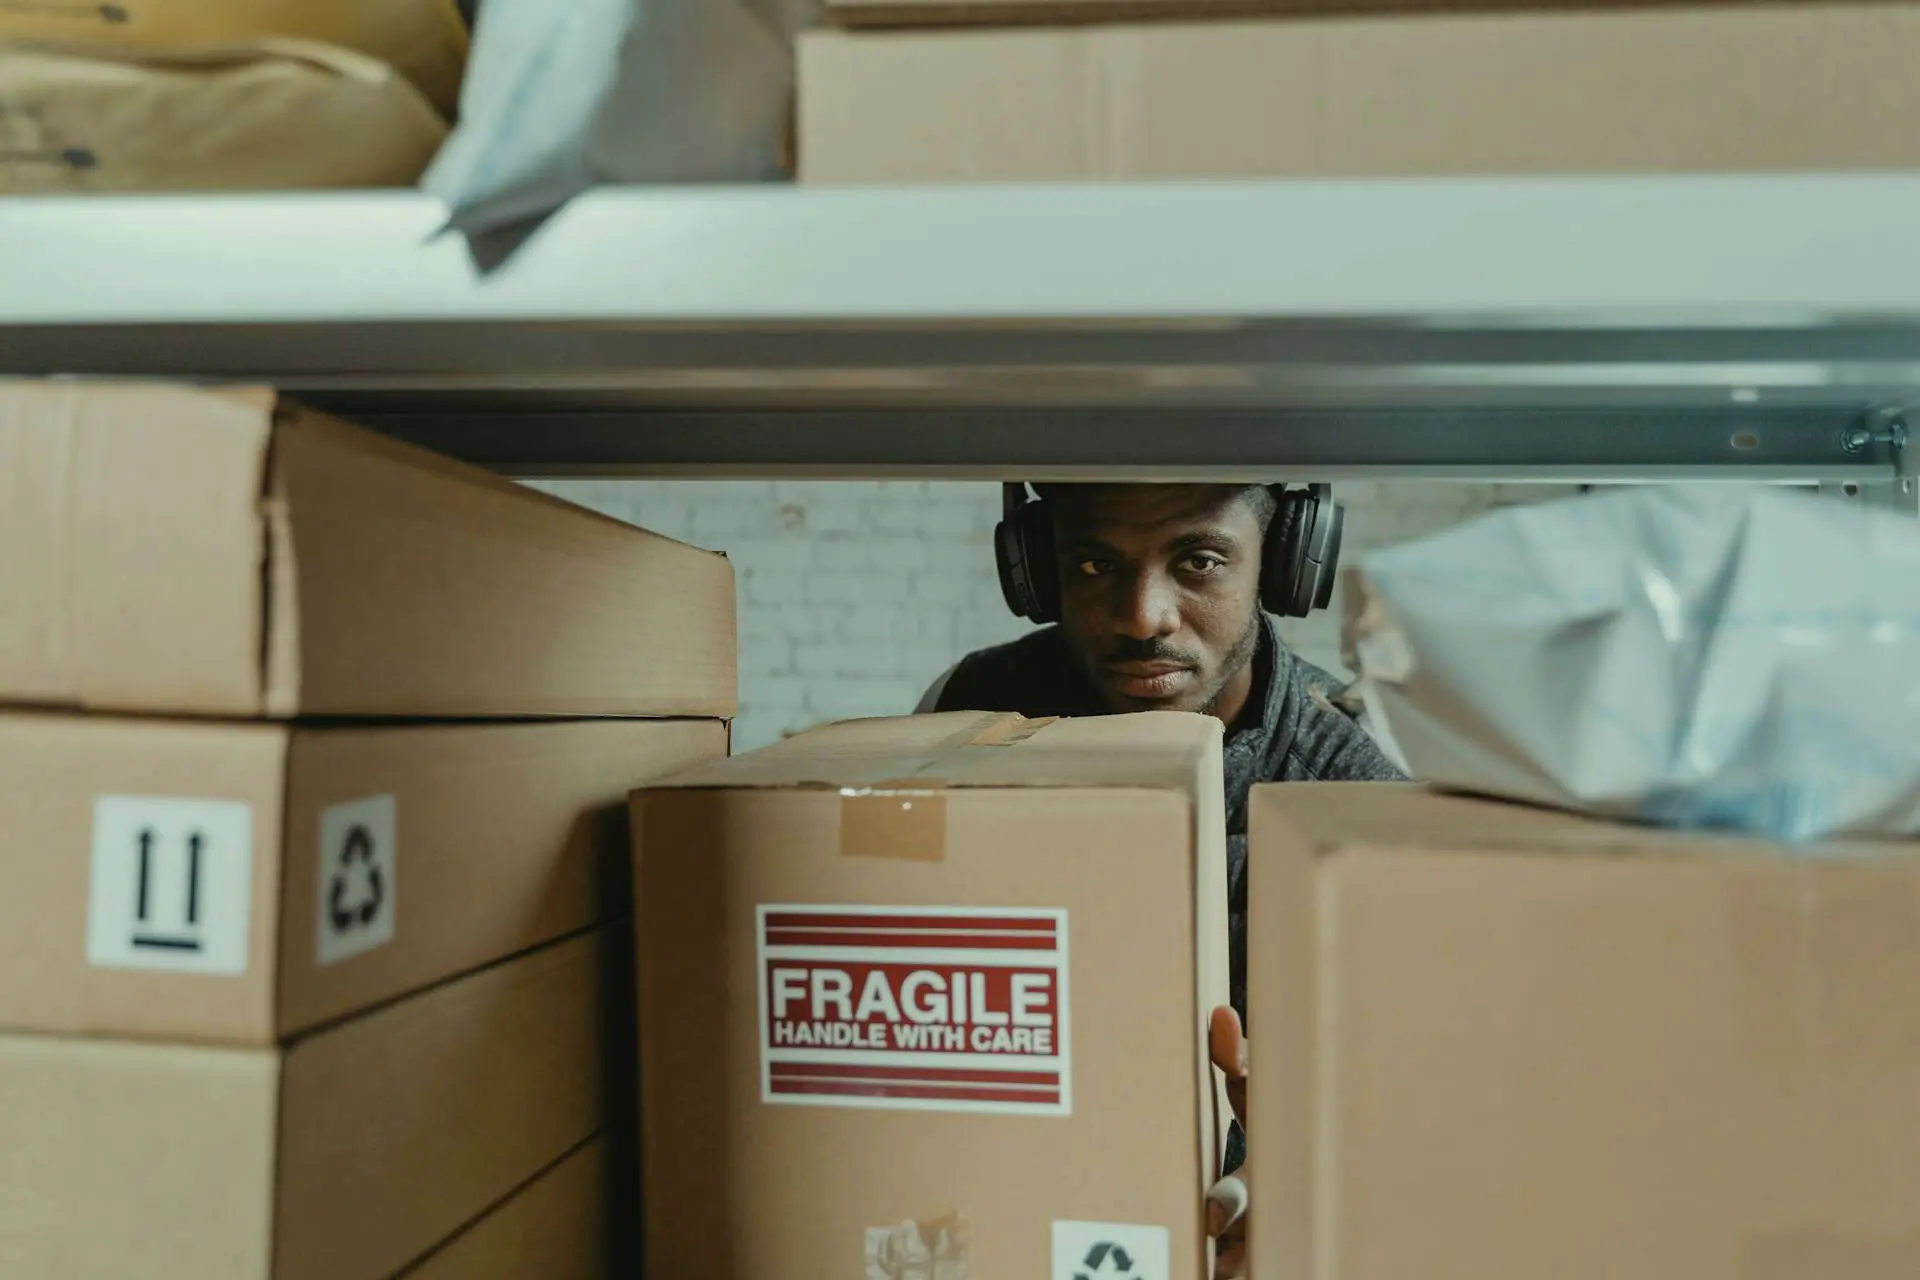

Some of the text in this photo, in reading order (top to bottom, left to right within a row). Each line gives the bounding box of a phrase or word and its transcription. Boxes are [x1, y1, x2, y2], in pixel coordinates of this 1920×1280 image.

[773, 969, 1052, 1025] FRAGILE
[774, 1021, 1052, 1053] HANDLE WITH CARE
